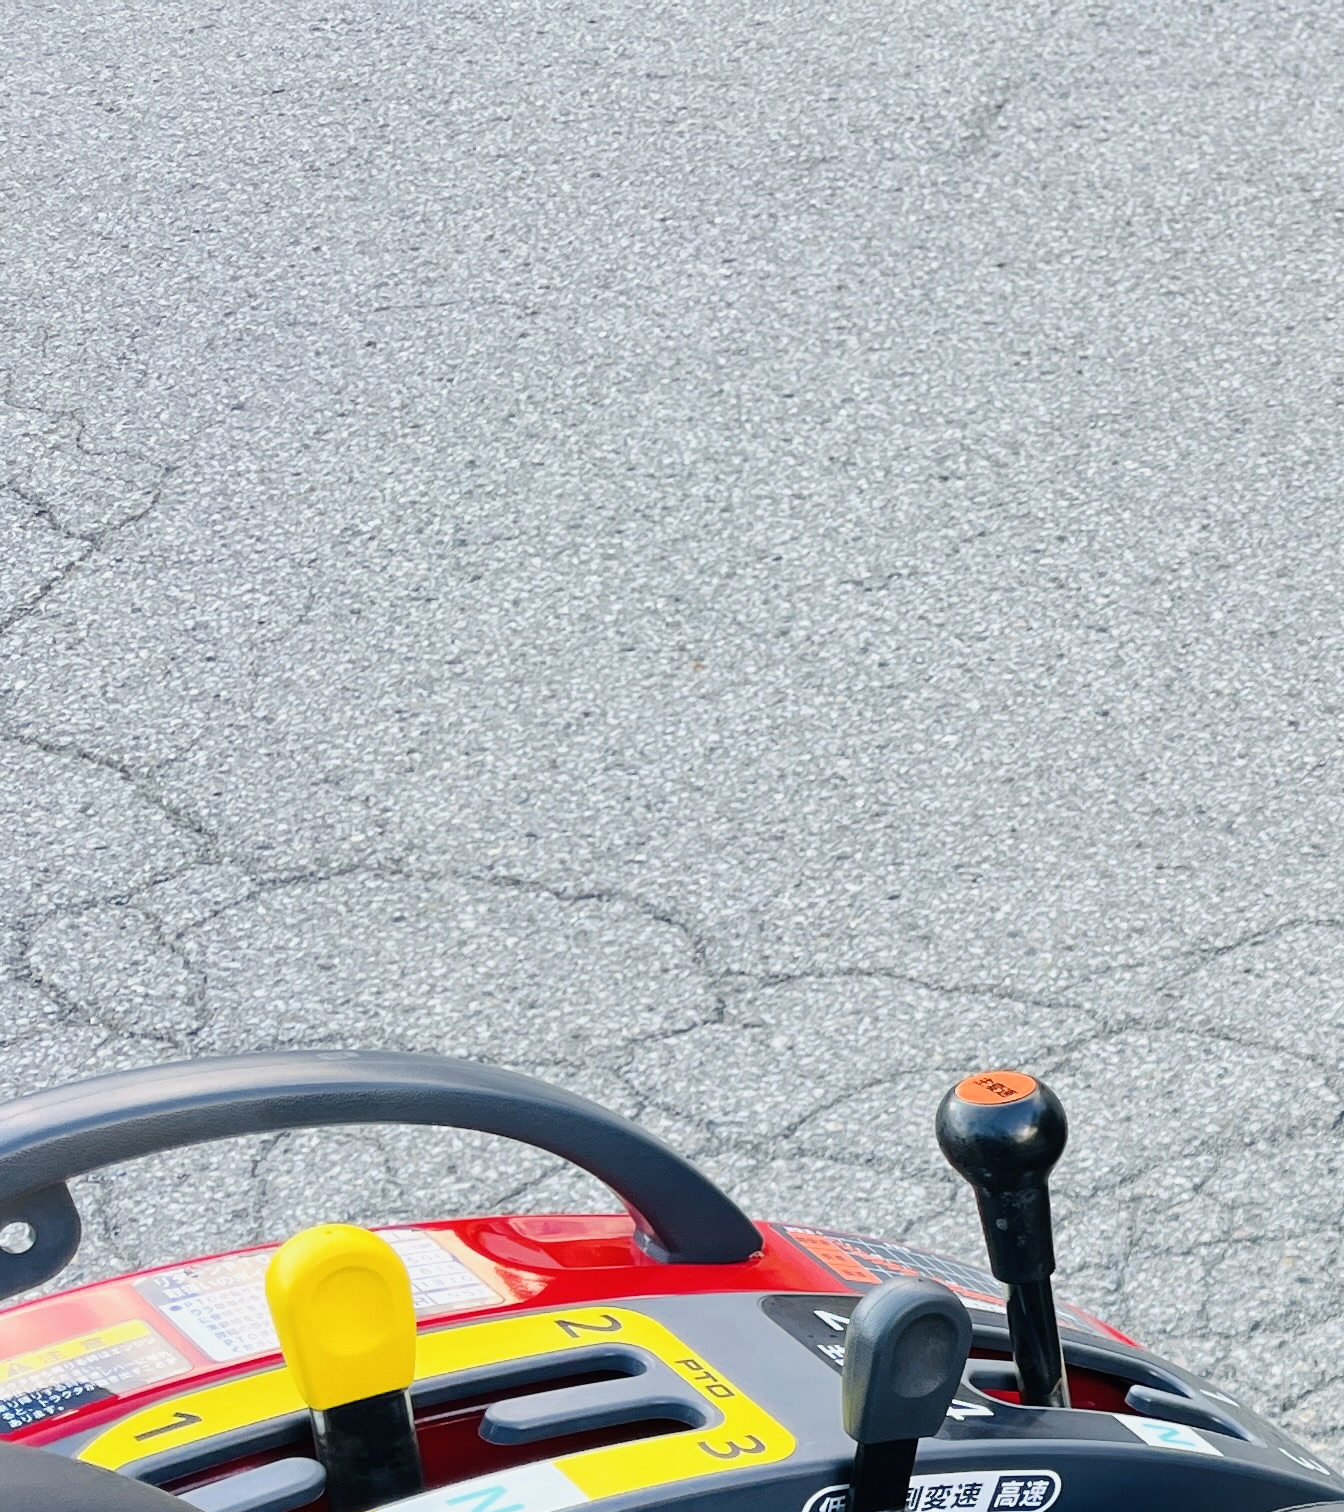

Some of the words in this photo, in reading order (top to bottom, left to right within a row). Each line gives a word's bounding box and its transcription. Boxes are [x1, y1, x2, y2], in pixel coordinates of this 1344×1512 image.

[554, 1314, 622, 1339] 2
[675, 1359, 735, 1398] PTO
[134, 1411, 203, 1441] 1
[1142, 1423, 1196, 1447] N
[697, 1434, 766, 1459] 3
[993, 1478, 1051, 1510] 高速
